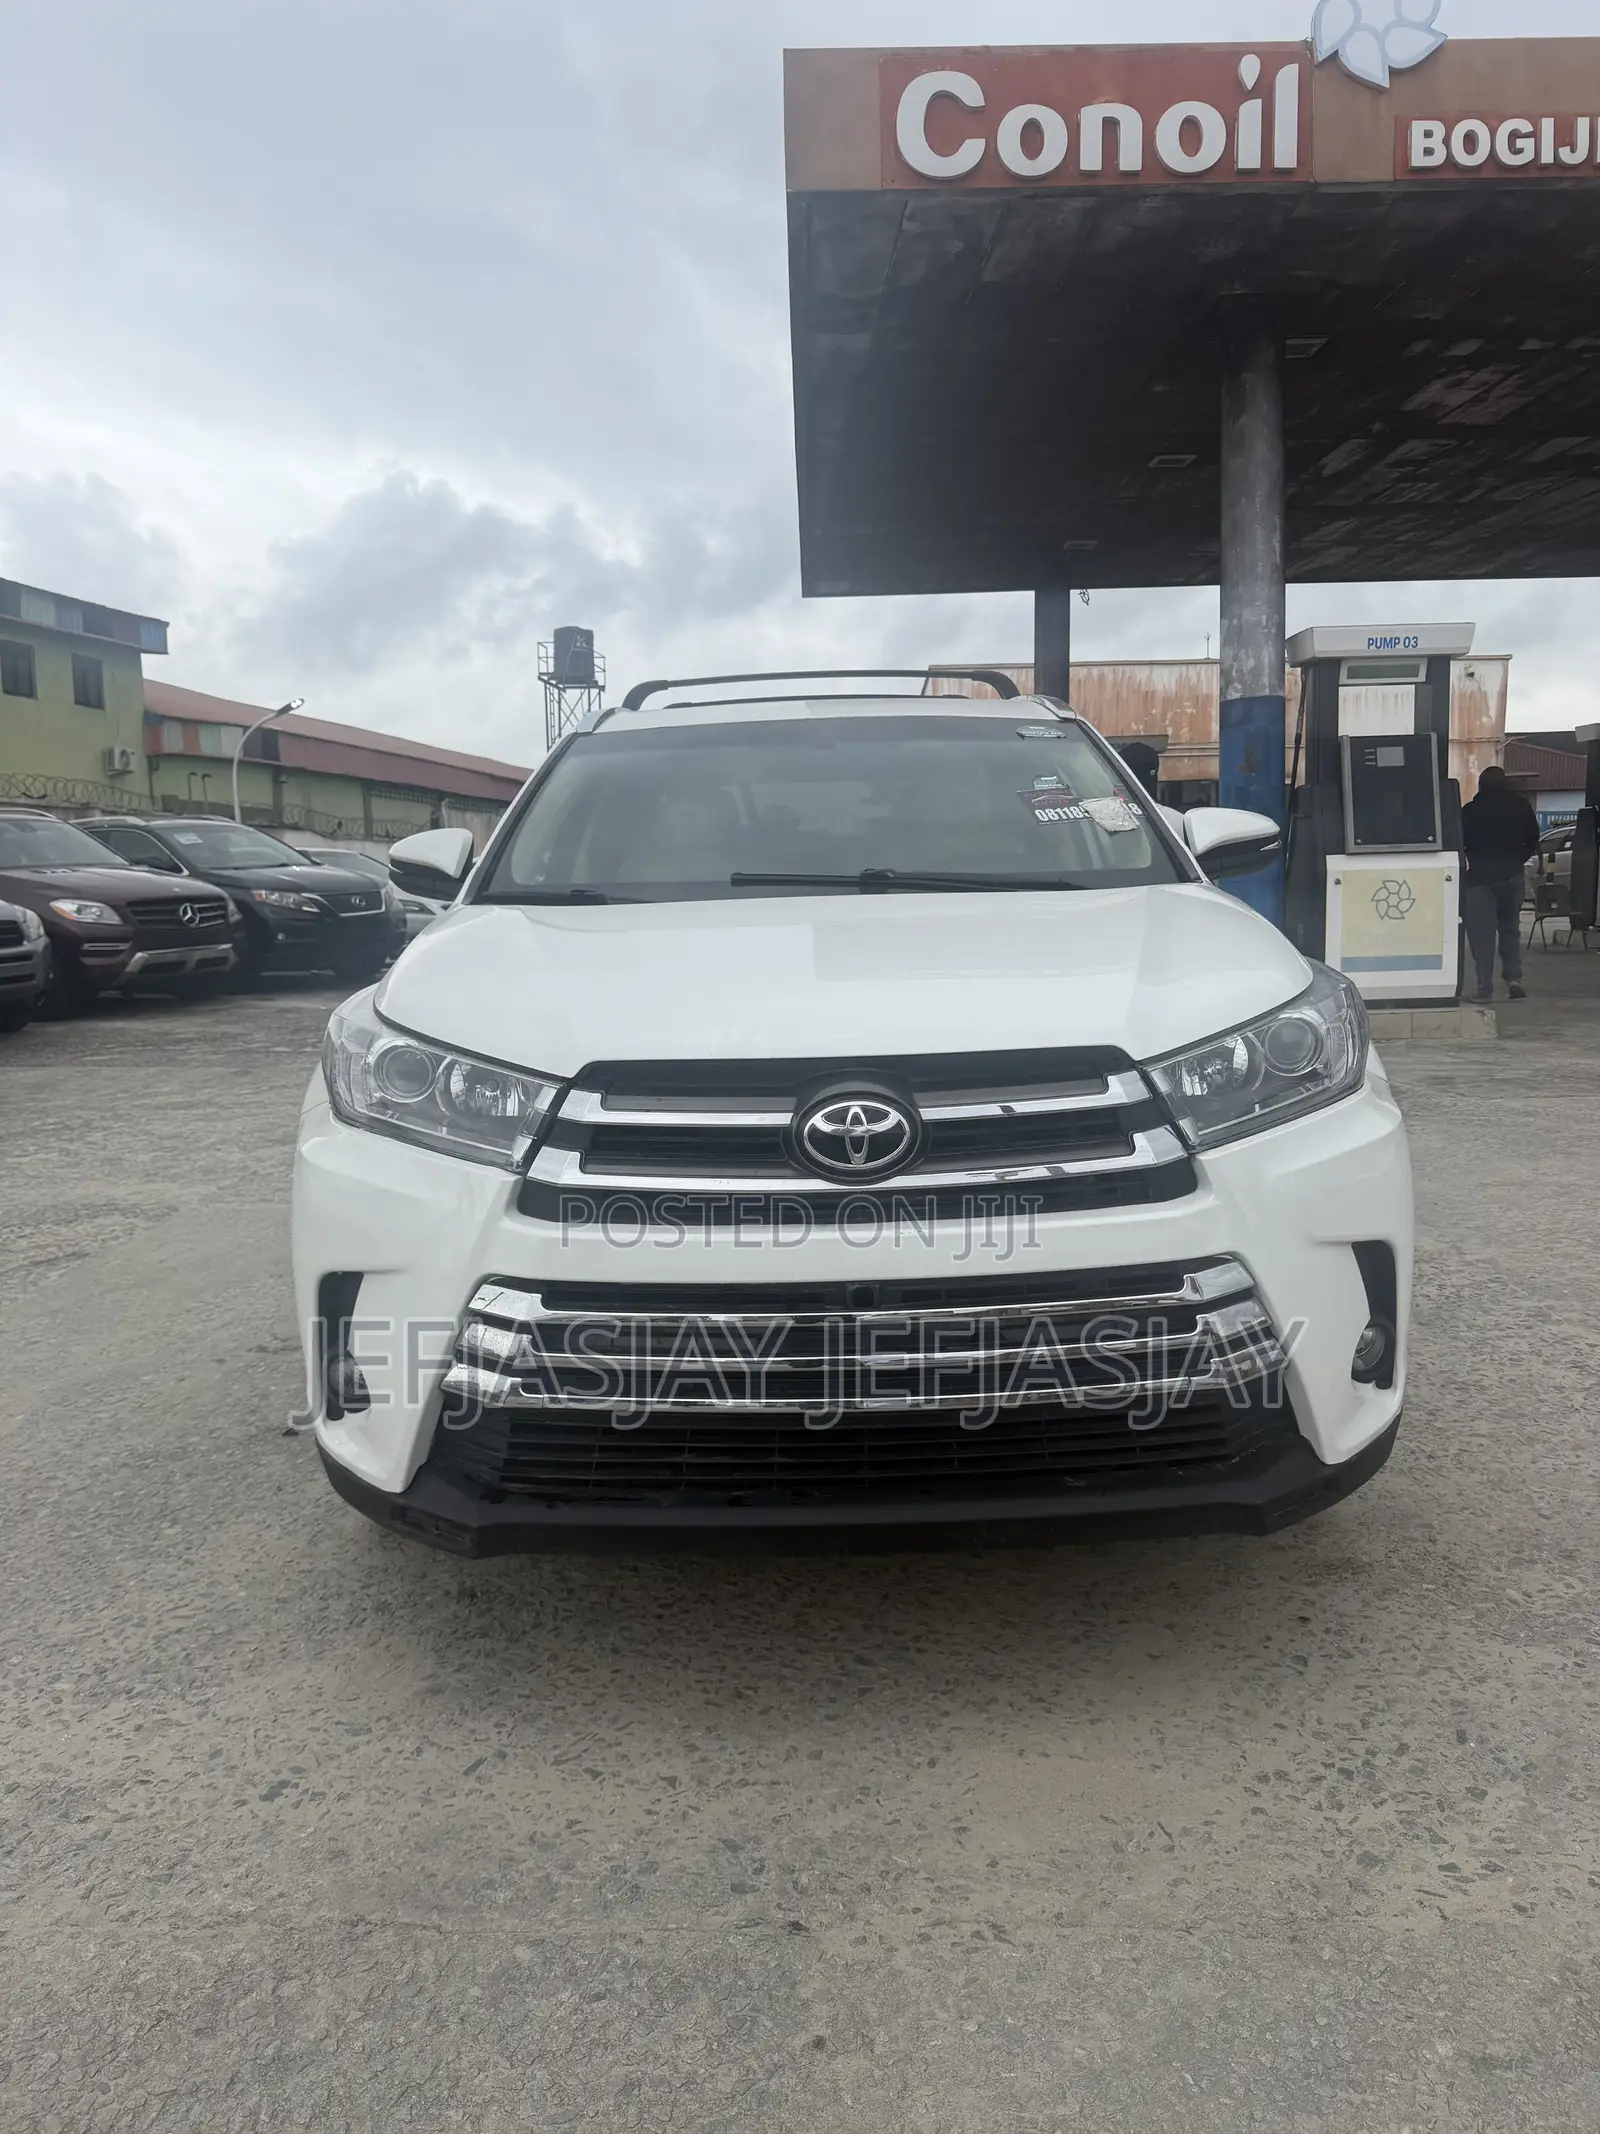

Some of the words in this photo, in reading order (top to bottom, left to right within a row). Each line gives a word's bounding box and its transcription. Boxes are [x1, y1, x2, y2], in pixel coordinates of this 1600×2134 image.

[895, 53, 1299, 180] Conoil
[1367, 636, 1401, 650] PUMP
[1403, 635, 1419, 649] 03
